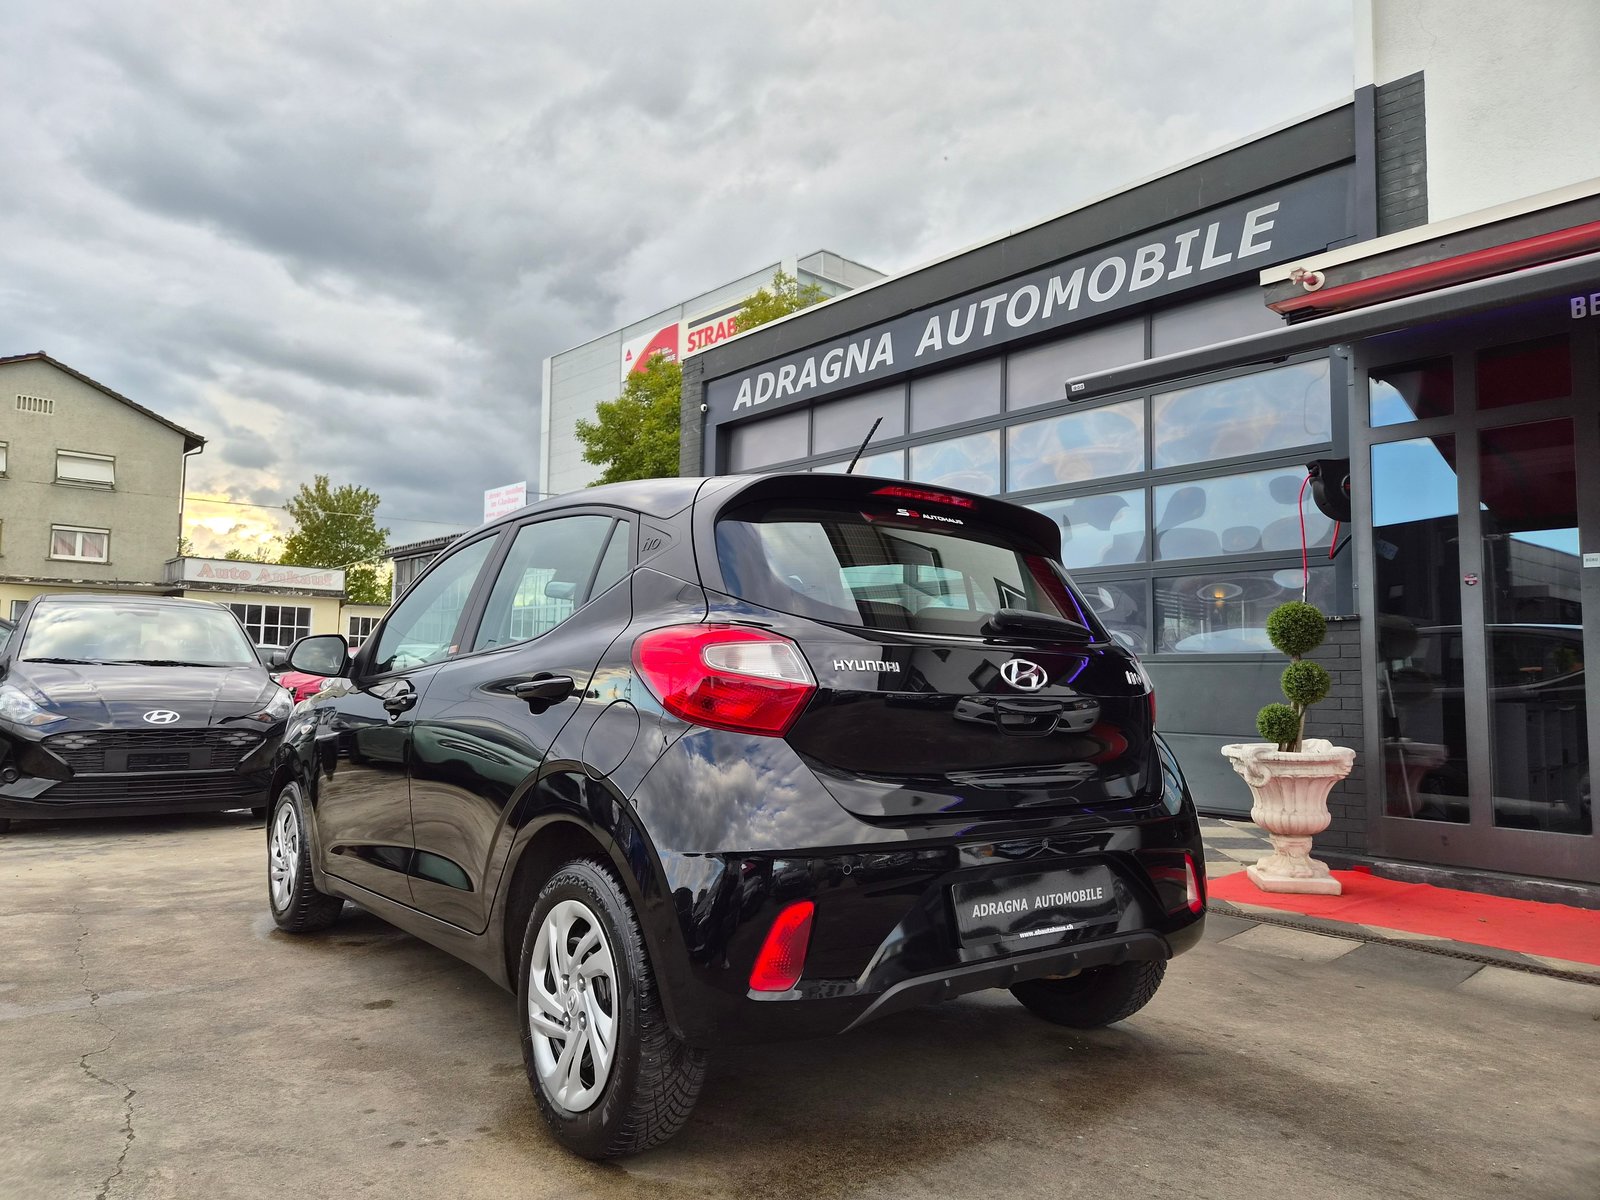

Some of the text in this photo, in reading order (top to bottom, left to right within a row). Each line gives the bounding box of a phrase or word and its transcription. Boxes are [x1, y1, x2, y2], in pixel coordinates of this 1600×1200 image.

[732, 201, 1280, 411] ADRAGNA AUTOMOBILE
[687, 316, 742, 352] STRAB
[197, 563, 332, 586] Auto Ankauf
[833, 659, 901, 673] HYUNDAI
[972, 887, 1103, 918] ADRAGNA AUTOMOBILE
